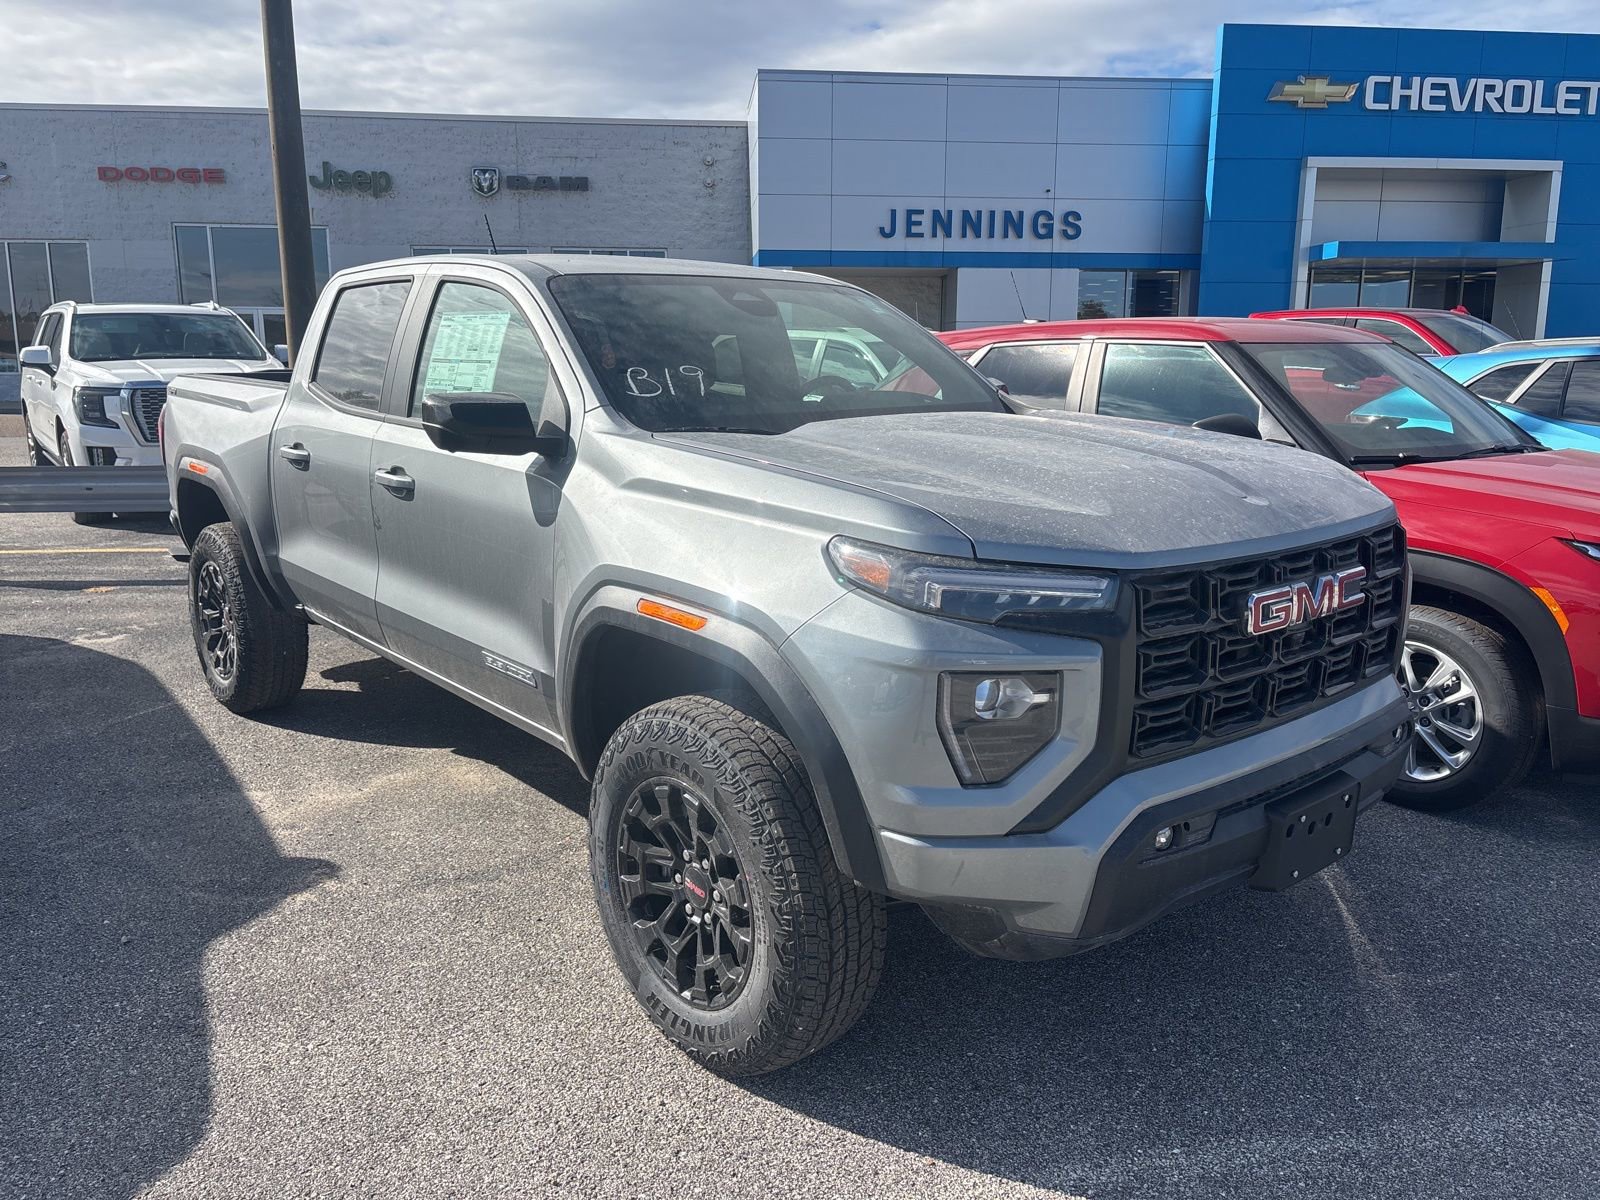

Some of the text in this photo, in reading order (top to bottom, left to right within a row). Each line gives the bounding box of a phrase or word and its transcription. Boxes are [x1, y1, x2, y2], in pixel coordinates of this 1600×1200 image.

[97, 166, 225, 184] DODGE
[309, 161, 392, 199] Jeep
[506, 175, 589, 191] RAM
[879, 208, 1083, 240] JENNINGS
[626, 365, 705, 397] B19
[1248, 566, 1366, 635] GMC
